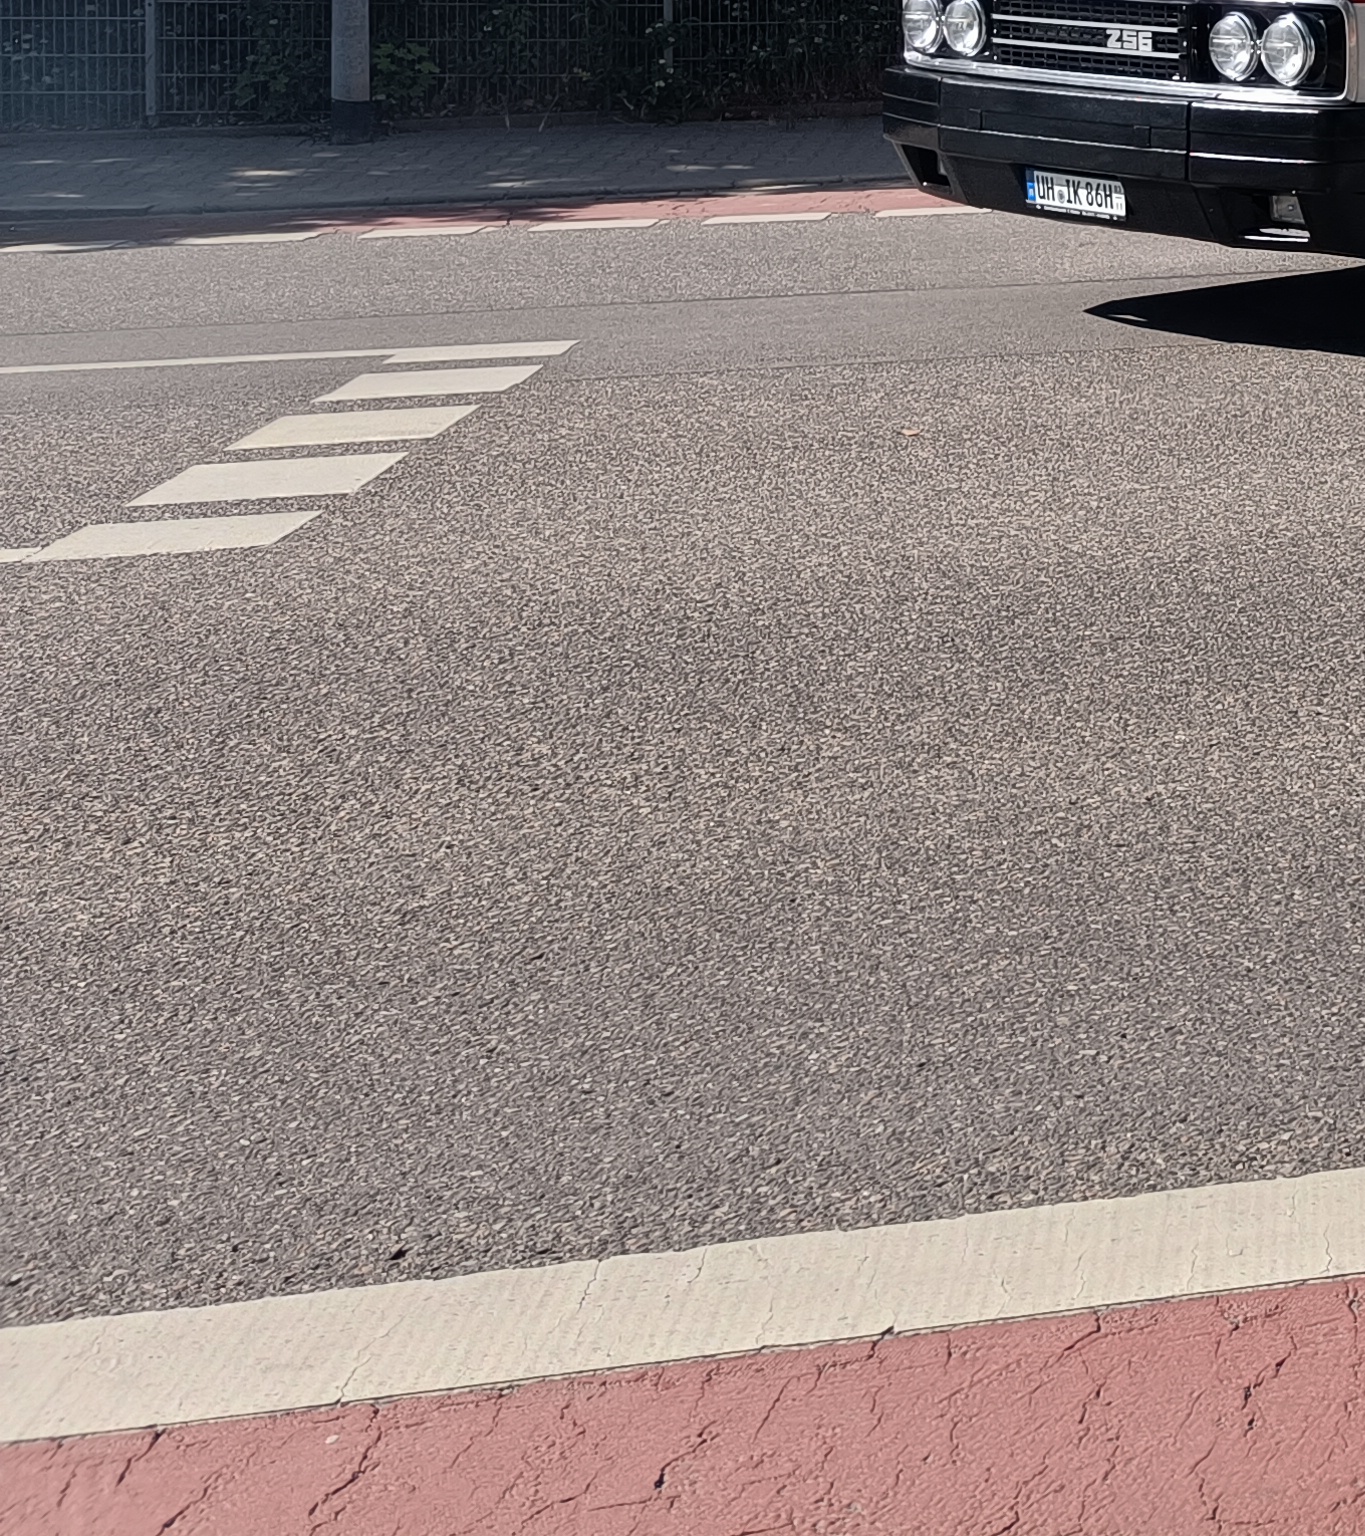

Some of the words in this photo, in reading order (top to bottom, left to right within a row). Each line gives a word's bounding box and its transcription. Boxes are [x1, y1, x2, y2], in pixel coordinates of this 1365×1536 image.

[1105, 28, 1154, 52] 256
[1065, 178, 1083, 206] IK
[1084, 181, 1114, 210] 86H
